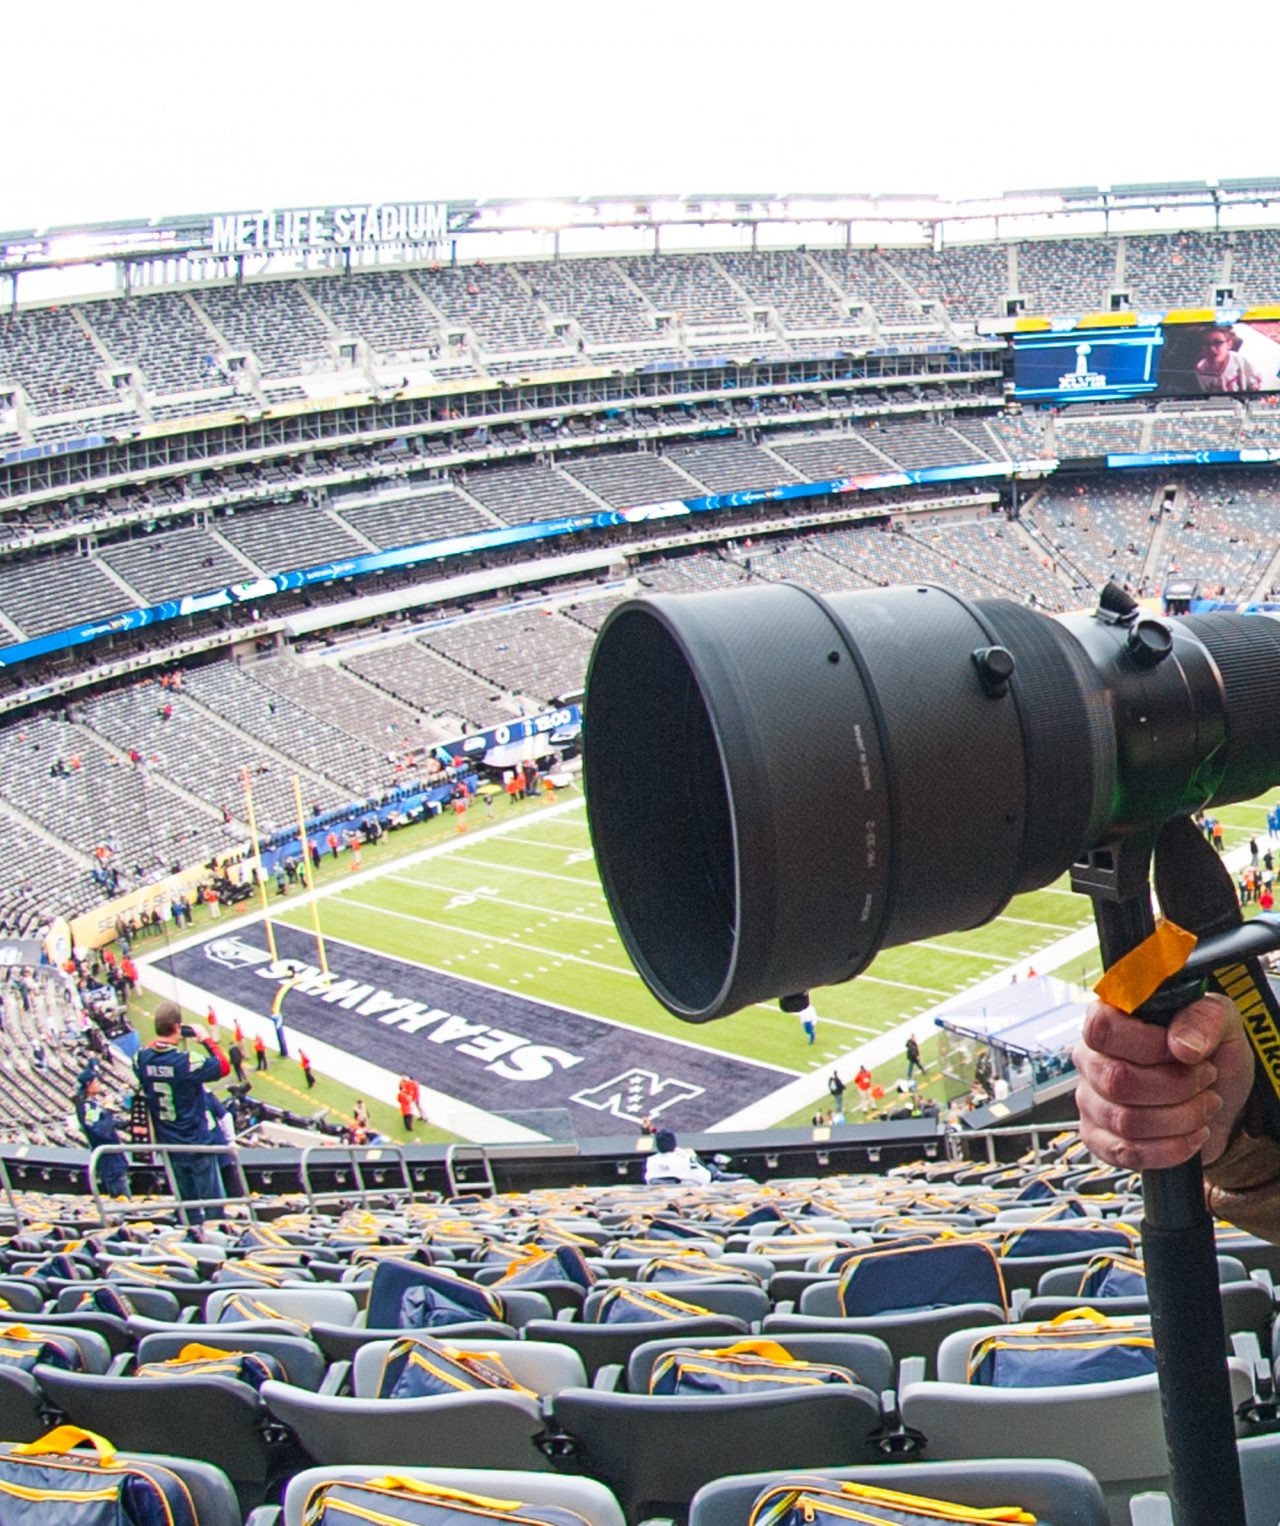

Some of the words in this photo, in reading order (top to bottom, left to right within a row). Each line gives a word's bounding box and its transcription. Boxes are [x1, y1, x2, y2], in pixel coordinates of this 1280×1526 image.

[211, 209, 328, 253] METLIFE
[334, 203, 448, 245] STADIUM
[255, 959, 584, 1082] SEAHAWKS
[153, 1081, 177, 1121] 3
